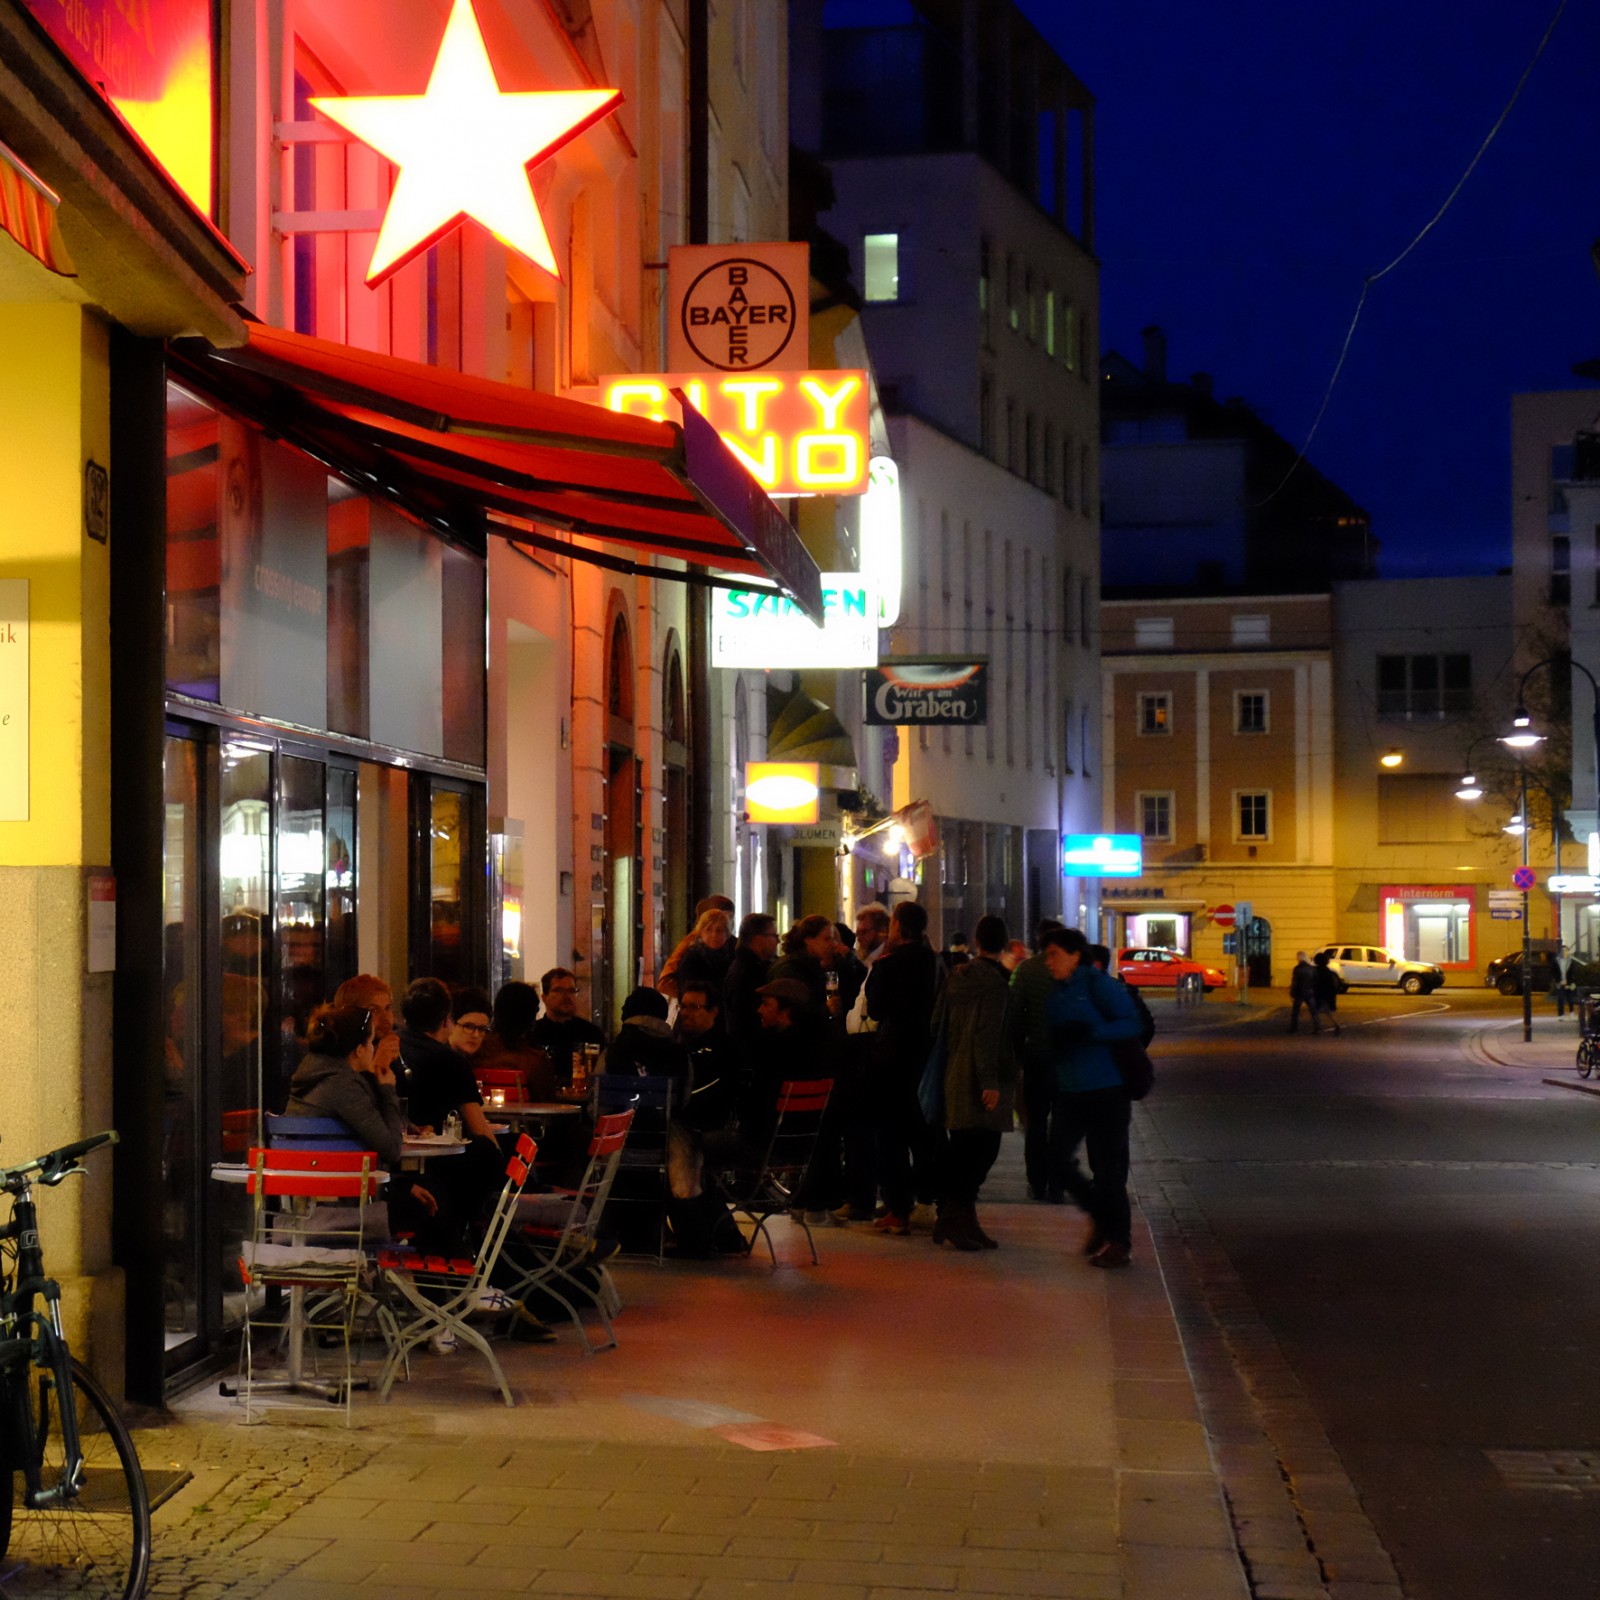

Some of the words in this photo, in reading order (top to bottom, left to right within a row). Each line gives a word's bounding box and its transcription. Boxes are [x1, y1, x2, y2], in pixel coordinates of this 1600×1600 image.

[690, 304, 788, 326] BAYER
[728, 266, 749, 365] BAYER
[875, 680, 978, 720] Graben
[1400, 888, 1455, 898] Internorm
